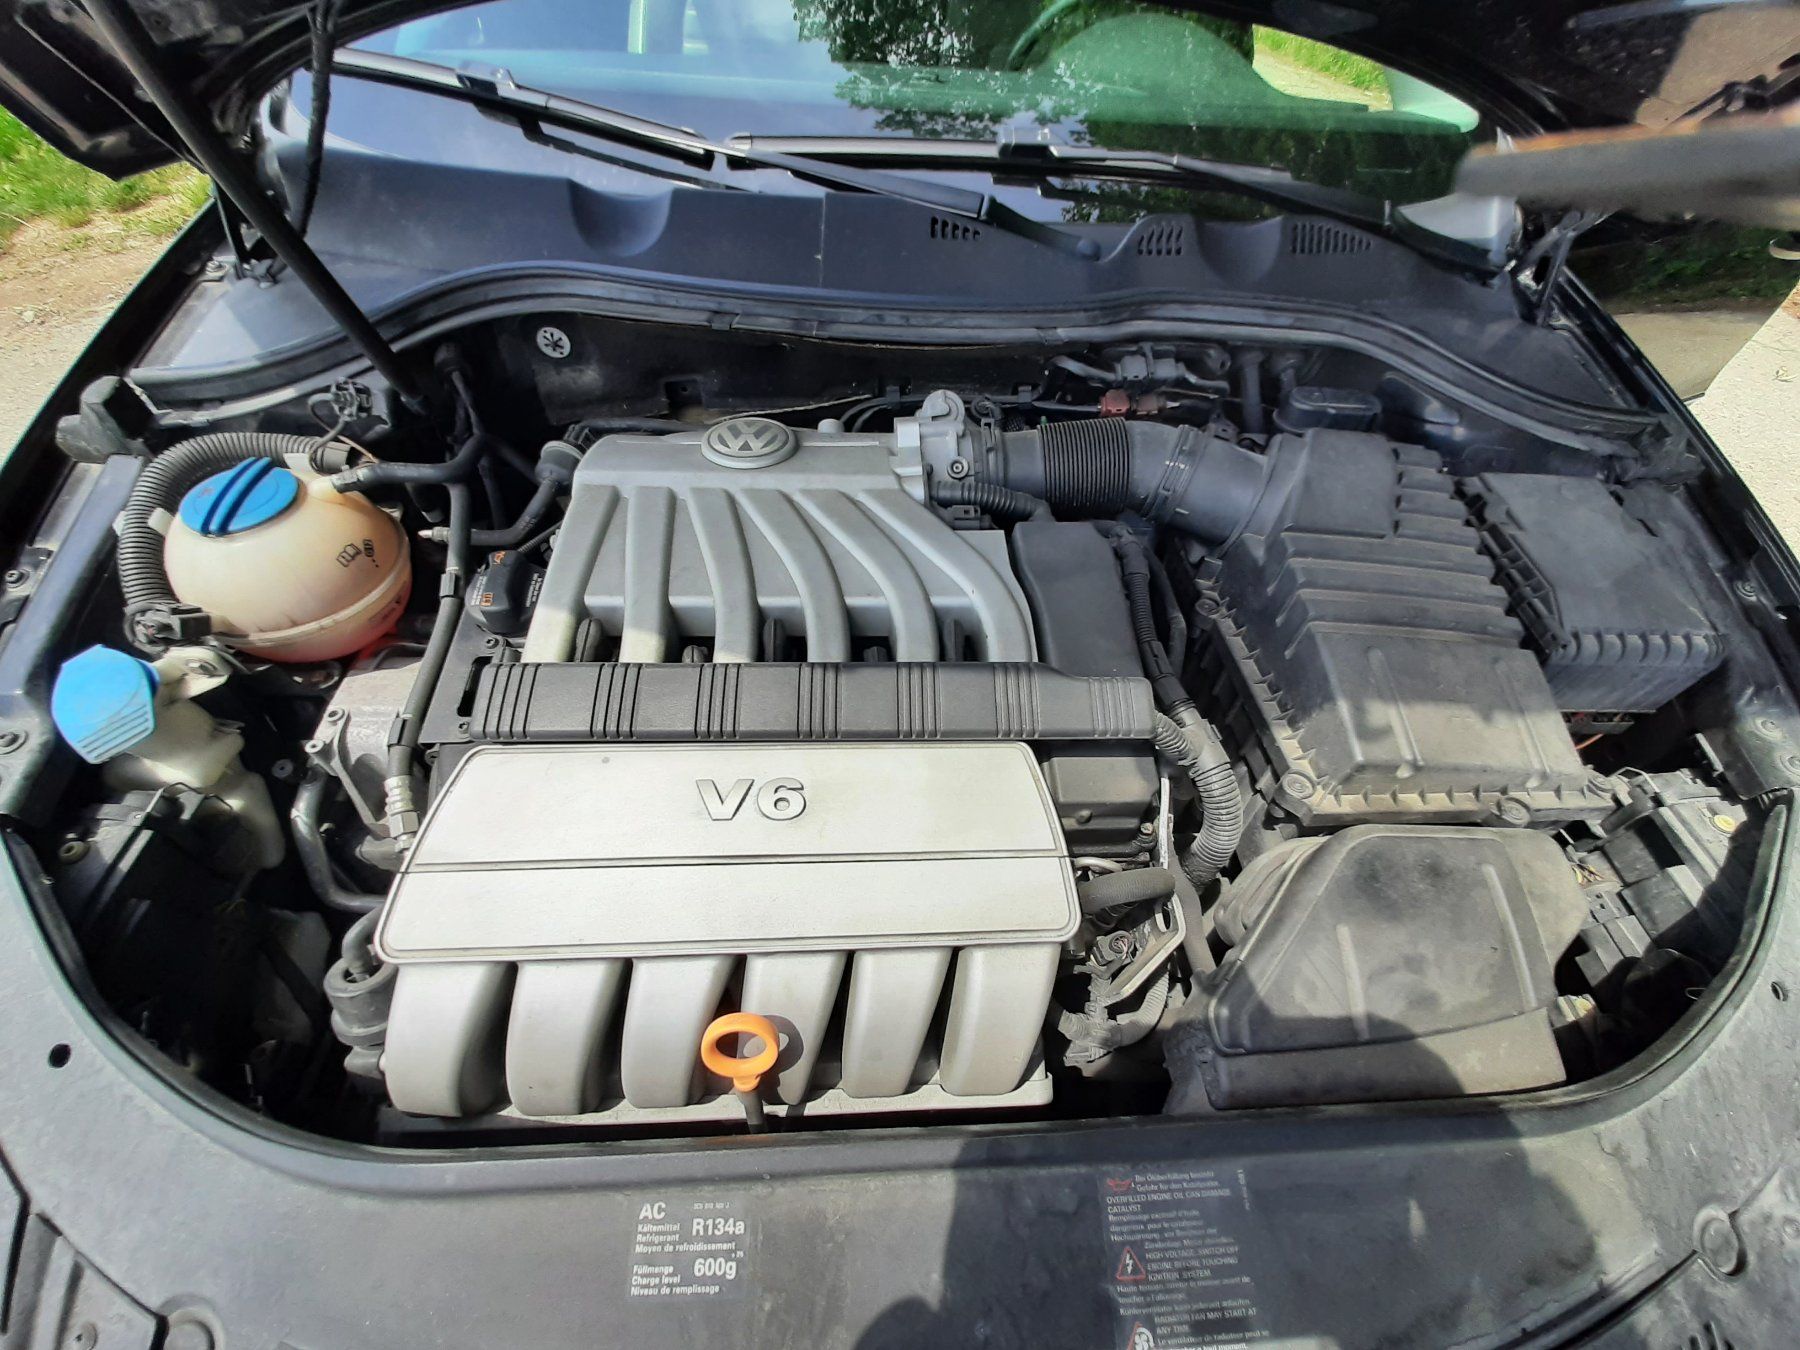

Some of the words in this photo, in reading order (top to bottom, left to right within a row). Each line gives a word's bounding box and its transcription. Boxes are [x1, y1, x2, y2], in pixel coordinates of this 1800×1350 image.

[695, 777, 807, 821] V6
[639, 1202, 666, 1220] AC
[637, 1222, 681, 1233] Kältemittel
[692, 1217, 745, 1236] R134a
[636, 1233, 680, 1244] Refrigerant
[635, 1244, 662, 1254] Moyen
[664, 1243, 674, 1252] de
[675, 1241, 736, 1252] refroidissement
[693, 1258, 737, 1280] 600g
[631, 1276, 660, 1286] Charge
[661, 1274, 680, 1284] level
[630, 1286, 658, 1296] Niveau
[660, 1285, 671, 1295] de
[672, 1284, 720, 1295] remplissage
